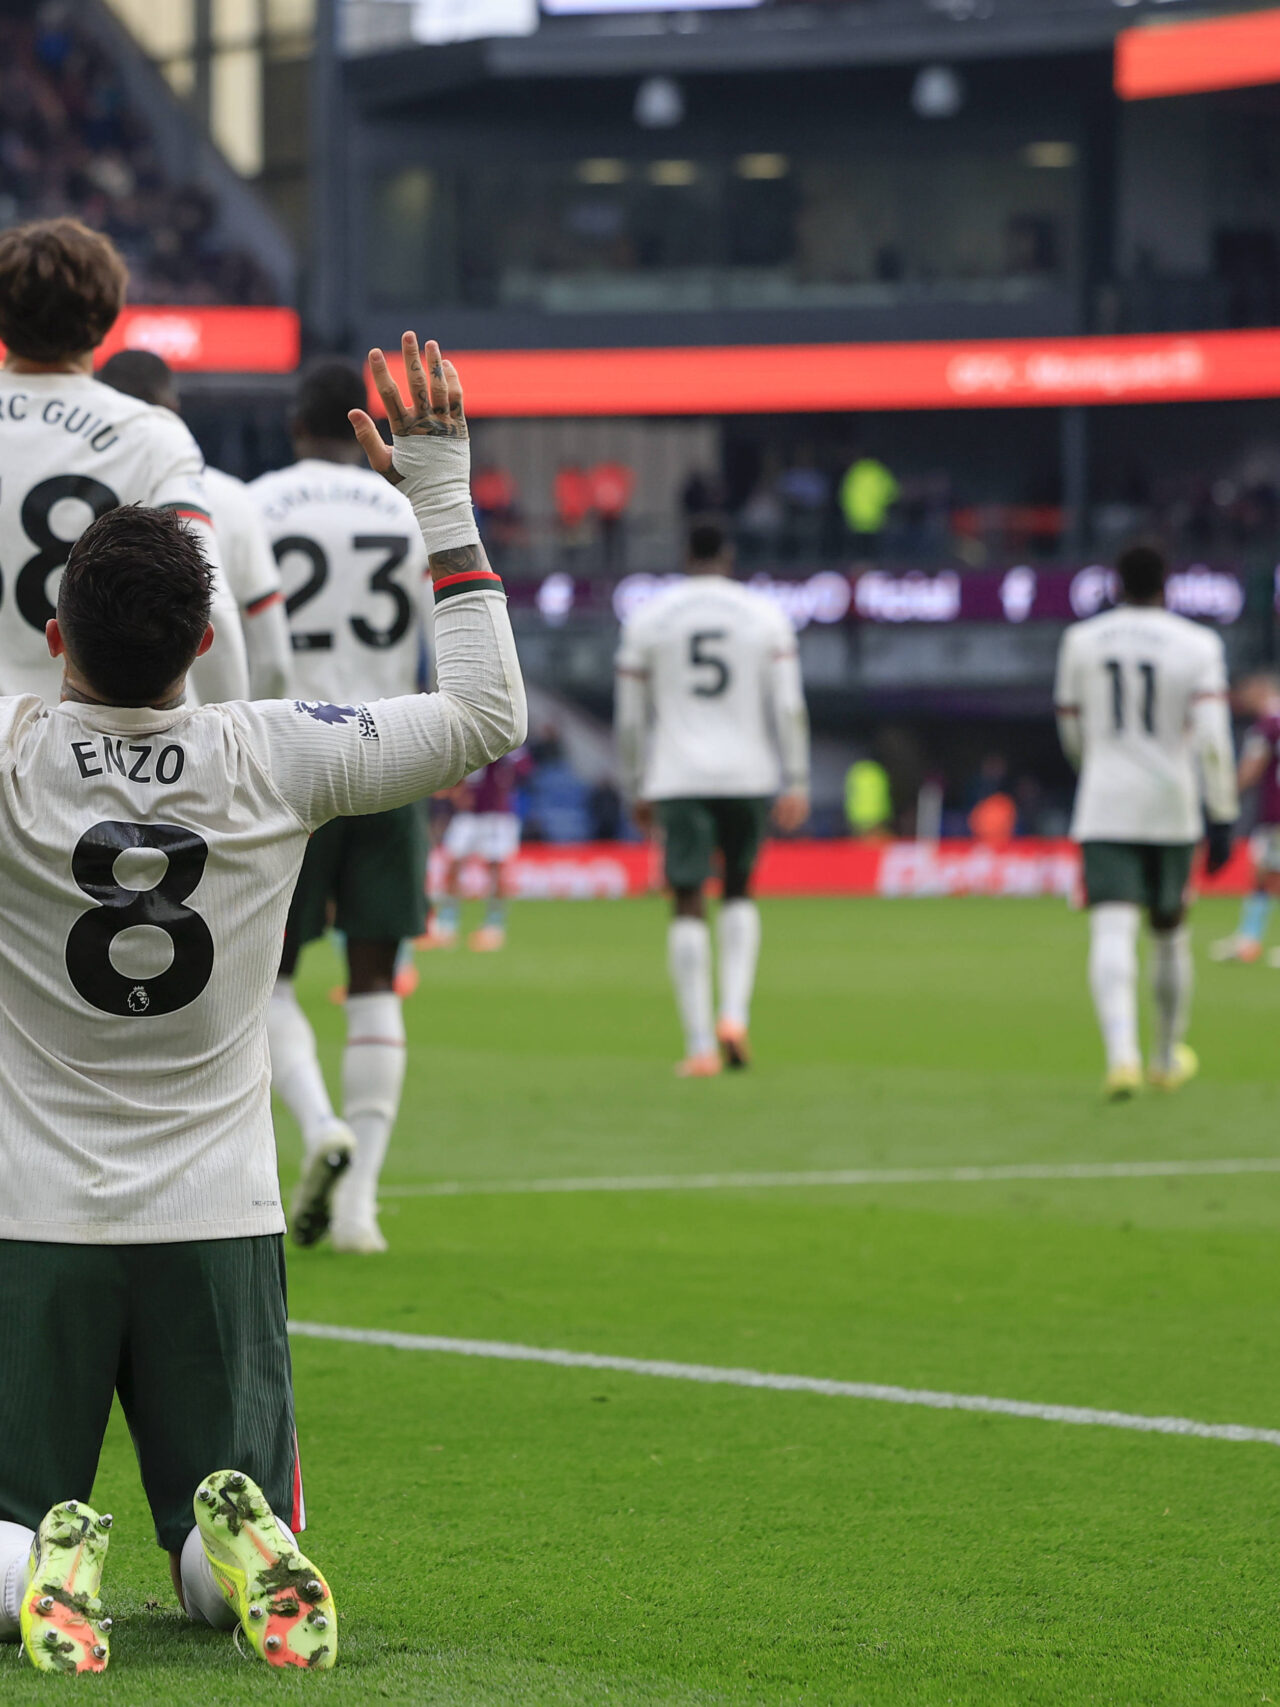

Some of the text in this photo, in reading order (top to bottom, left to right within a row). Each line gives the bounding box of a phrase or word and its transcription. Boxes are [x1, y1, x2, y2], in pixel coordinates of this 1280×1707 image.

[41, 398, 119, 452] GUIU
[272, 534, 413, 648] 23
[688, 630, 731, 697] 5
[1105, 660, 1157, 734] 11
[71, 736, 186, 785] ENZO
[65, 820, 215, 1018] 8
